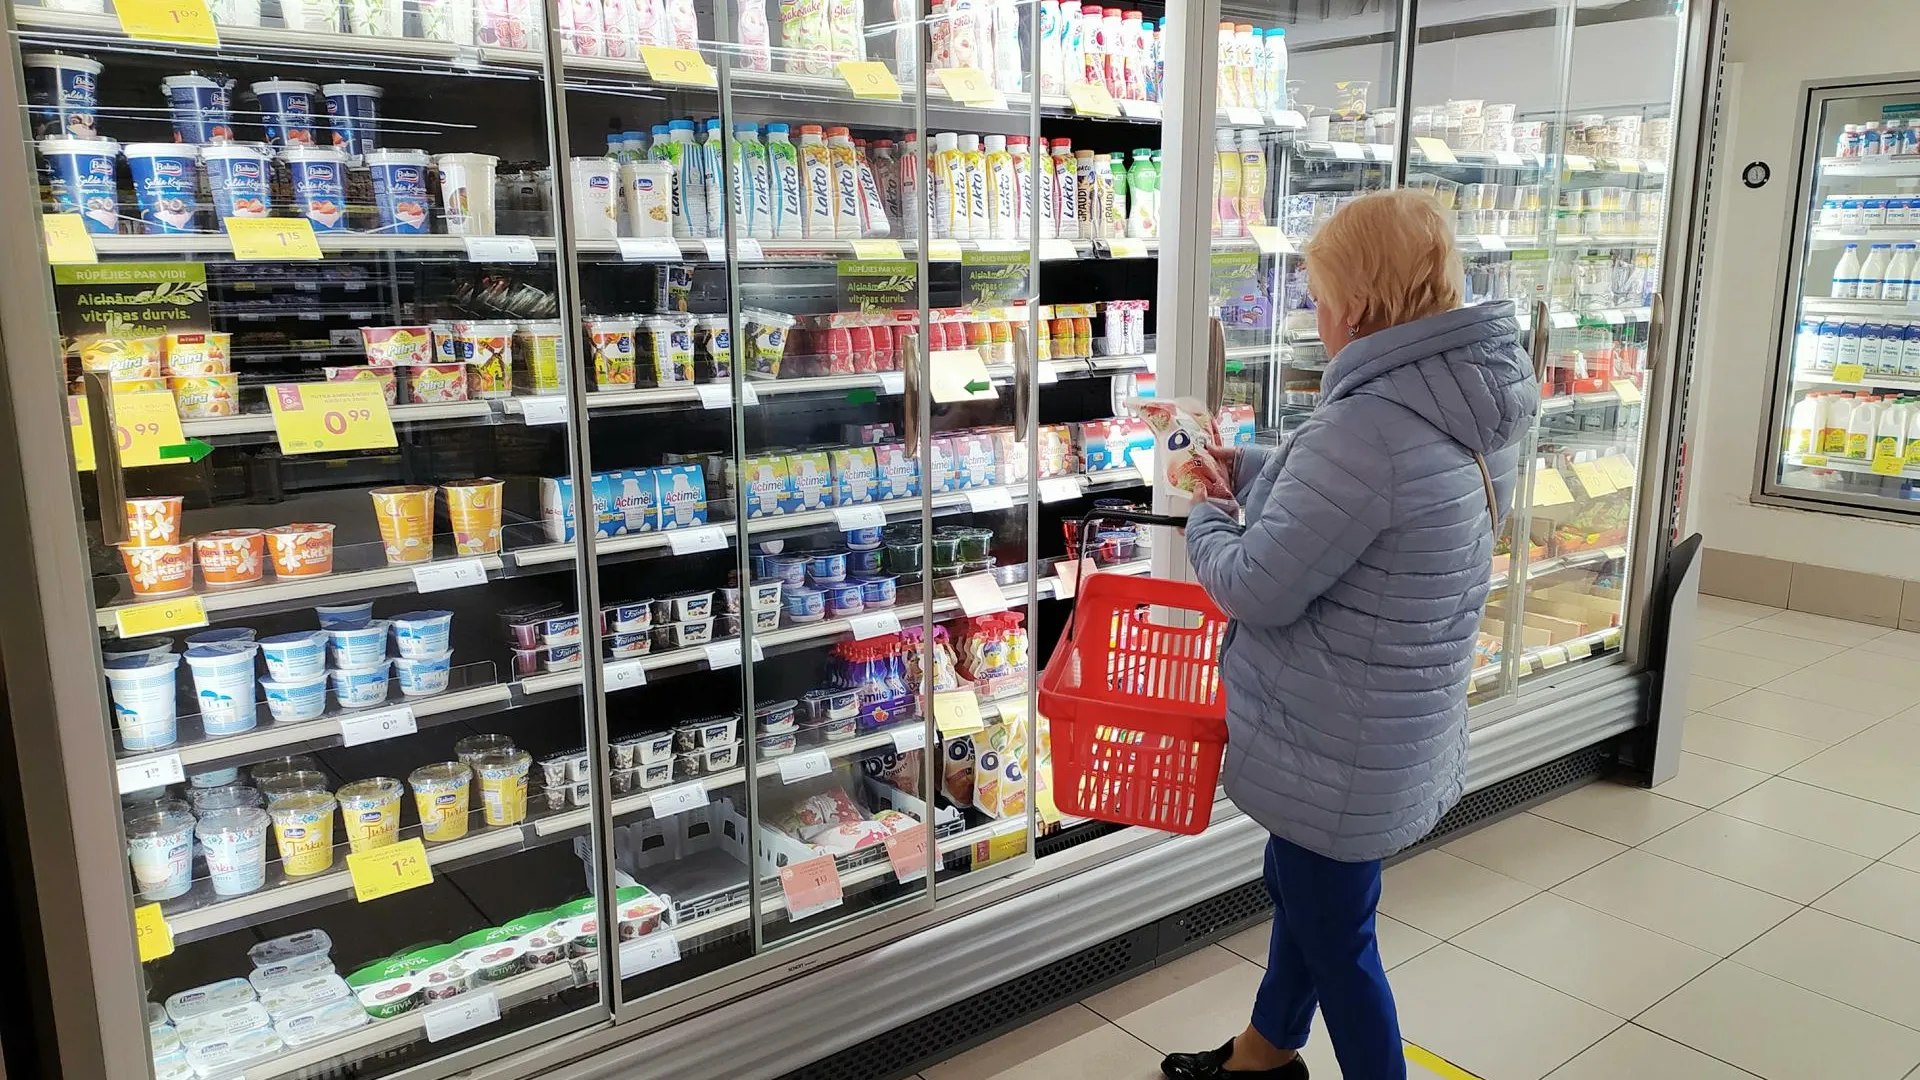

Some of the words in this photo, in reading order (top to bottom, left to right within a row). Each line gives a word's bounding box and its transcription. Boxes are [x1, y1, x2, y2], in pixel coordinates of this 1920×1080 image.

[814, 168, 829, 216] Lakto
[842, 169, 856, 217] Lakto
[1063, 175, 1075, 218] Lakto
[134, 270, 156, 279] PAR
[142, 308, 191, 322] durvis.
[844, 468, 872, 481] Actimel
[884, 463, 914, 477] Actimel
[752, 477, 785, 492] Actimel
[795, 473, 826, 488] Actimel
[614, 492, 652, 510] Actimel
[665, 488, 701, 504] Actimel
